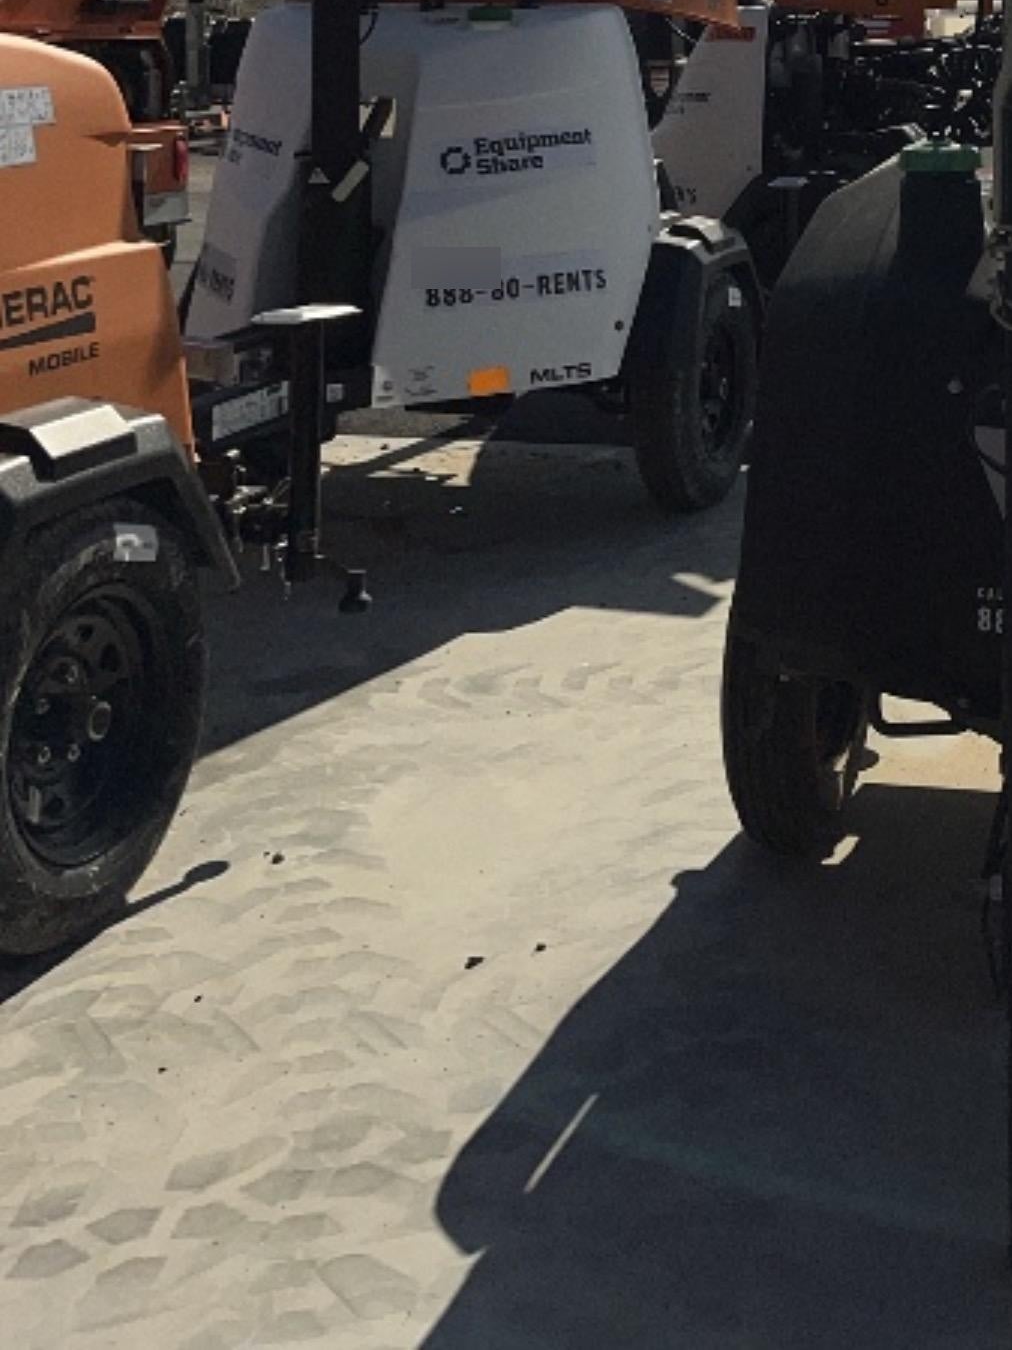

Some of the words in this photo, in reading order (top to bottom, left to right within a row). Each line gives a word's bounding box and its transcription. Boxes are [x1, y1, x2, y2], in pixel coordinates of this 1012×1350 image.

[473, 128, 592, 156] Equipment
[476, 154, 544, 175] Share
[0, 275, 96, 329] ERAC
[29, 341, 100, 377] MOBILE
[530, 362, 592, 385] MLTS
